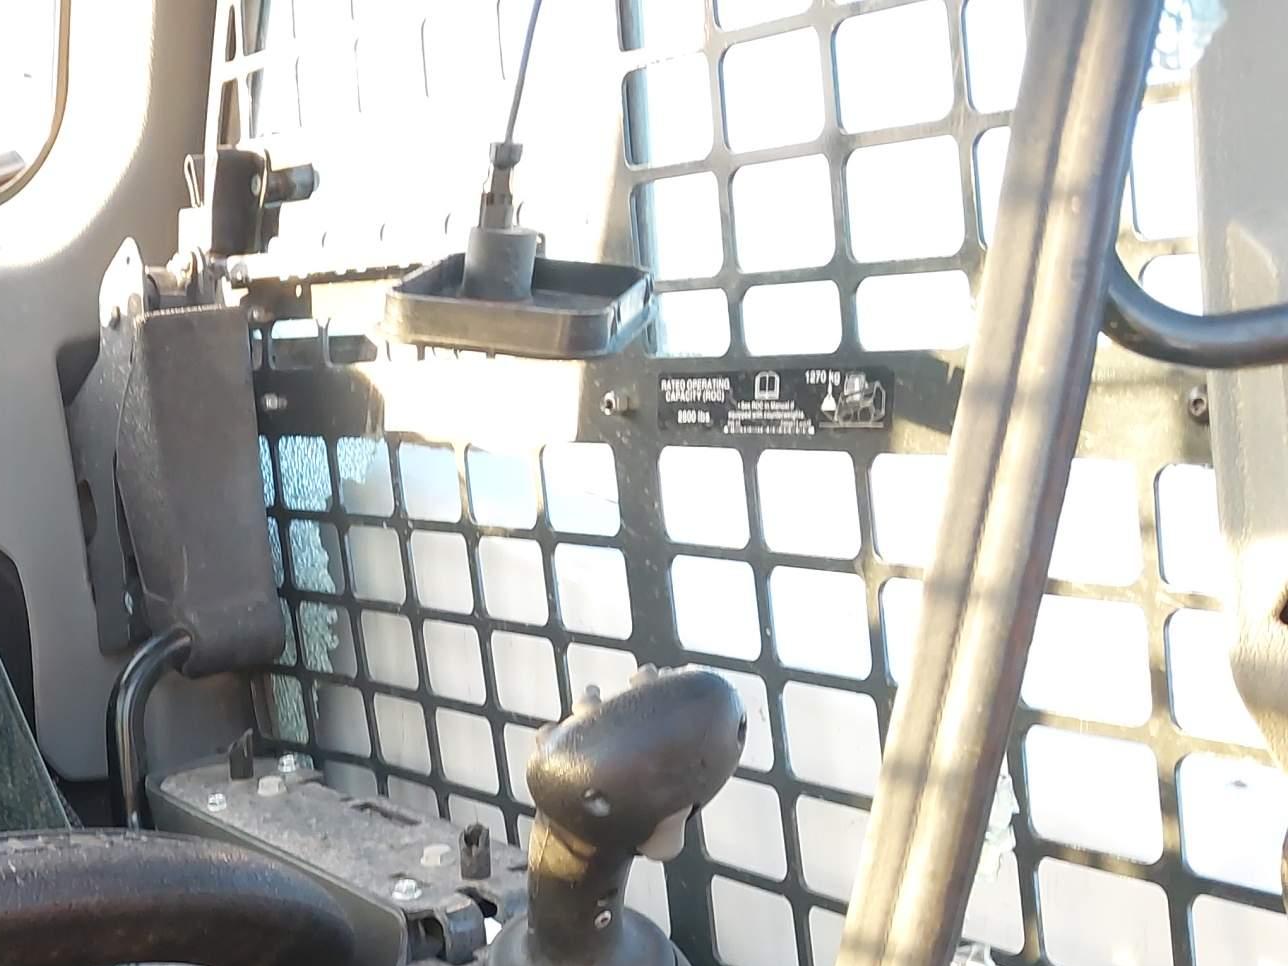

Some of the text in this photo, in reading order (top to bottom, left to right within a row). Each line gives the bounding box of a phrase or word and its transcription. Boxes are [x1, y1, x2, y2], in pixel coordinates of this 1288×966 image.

[661, 377, 731, 391] RATED OPERATING
[665, 389, 702, 402] CAPACITY
